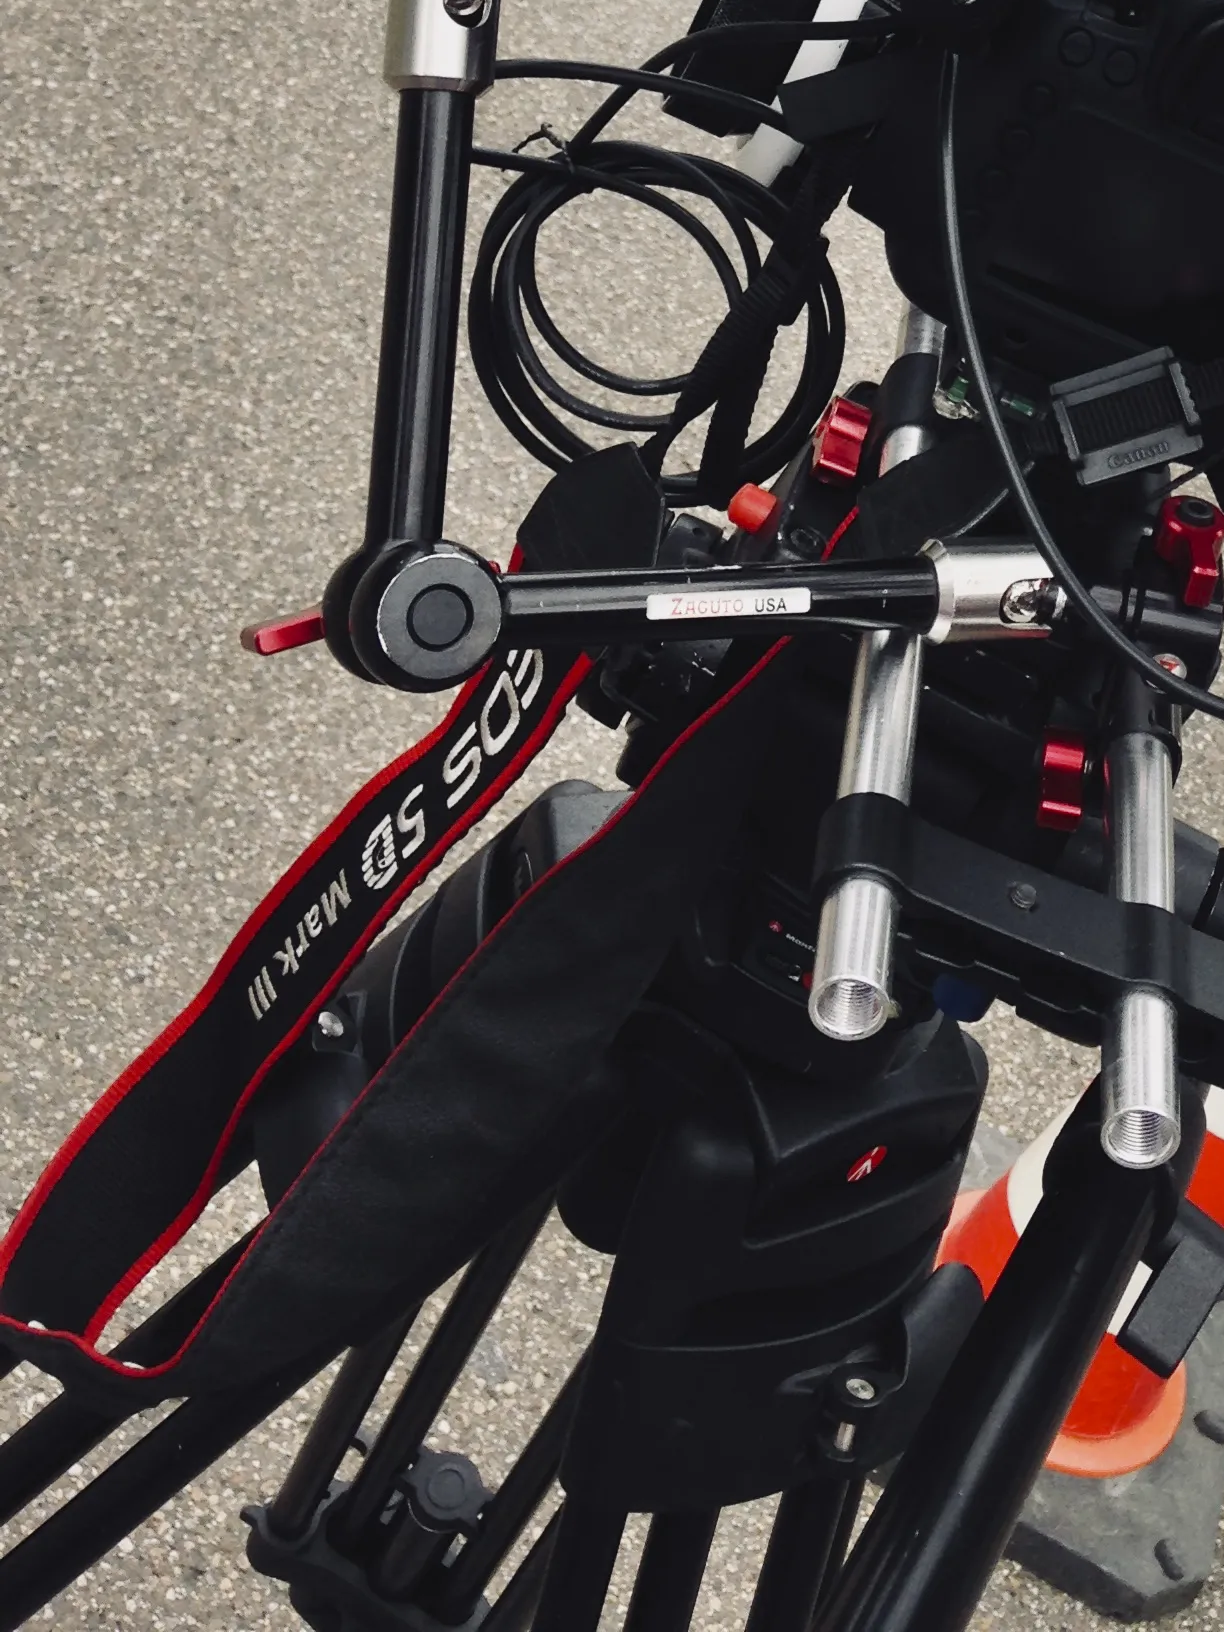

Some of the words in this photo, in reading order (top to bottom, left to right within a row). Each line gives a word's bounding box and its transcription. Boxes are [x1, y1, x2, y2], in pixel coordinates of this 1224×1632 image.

[1107, 441, 1169, 469] Canon
[755, 597, 787, 613] USA
[361, 783, 426, 890] 5D
[272, 868, 352, 976] Mark
